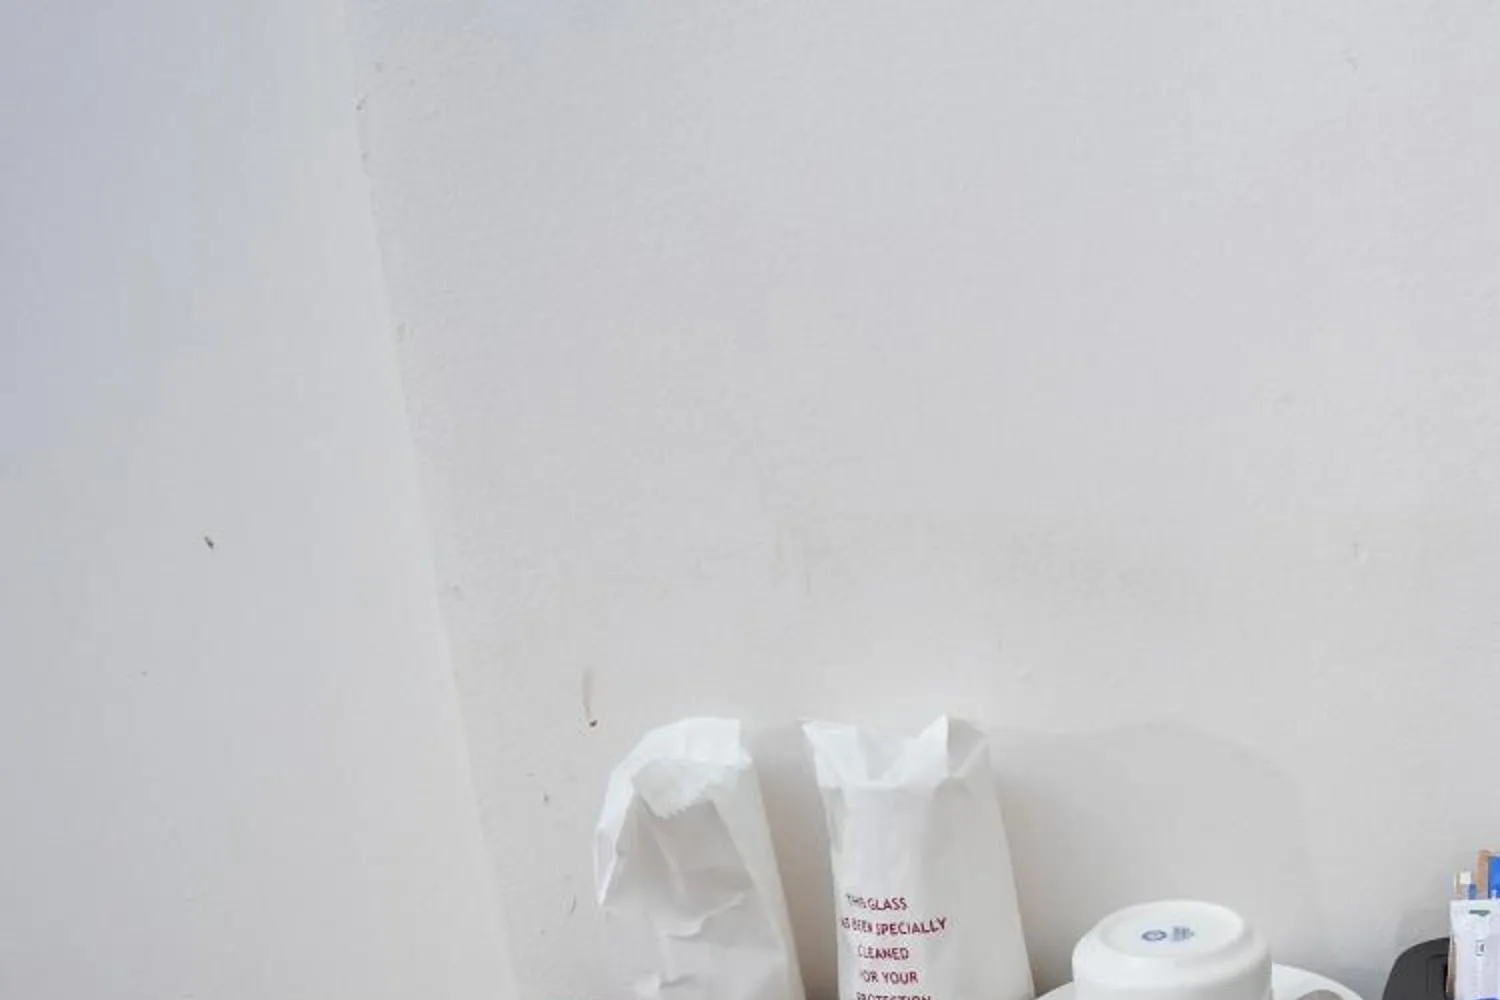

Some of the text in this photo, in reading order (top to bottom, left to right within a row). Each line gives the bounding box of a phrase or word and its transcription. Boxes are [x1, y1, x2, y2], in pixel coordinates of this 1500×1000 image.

[867, 897, 908, 911] GLASS
[876, 916, 947, 937] SPECIALLY
[857, 945, 910, 961] CLEANED
[881, 971, 919, 985] YOUR
